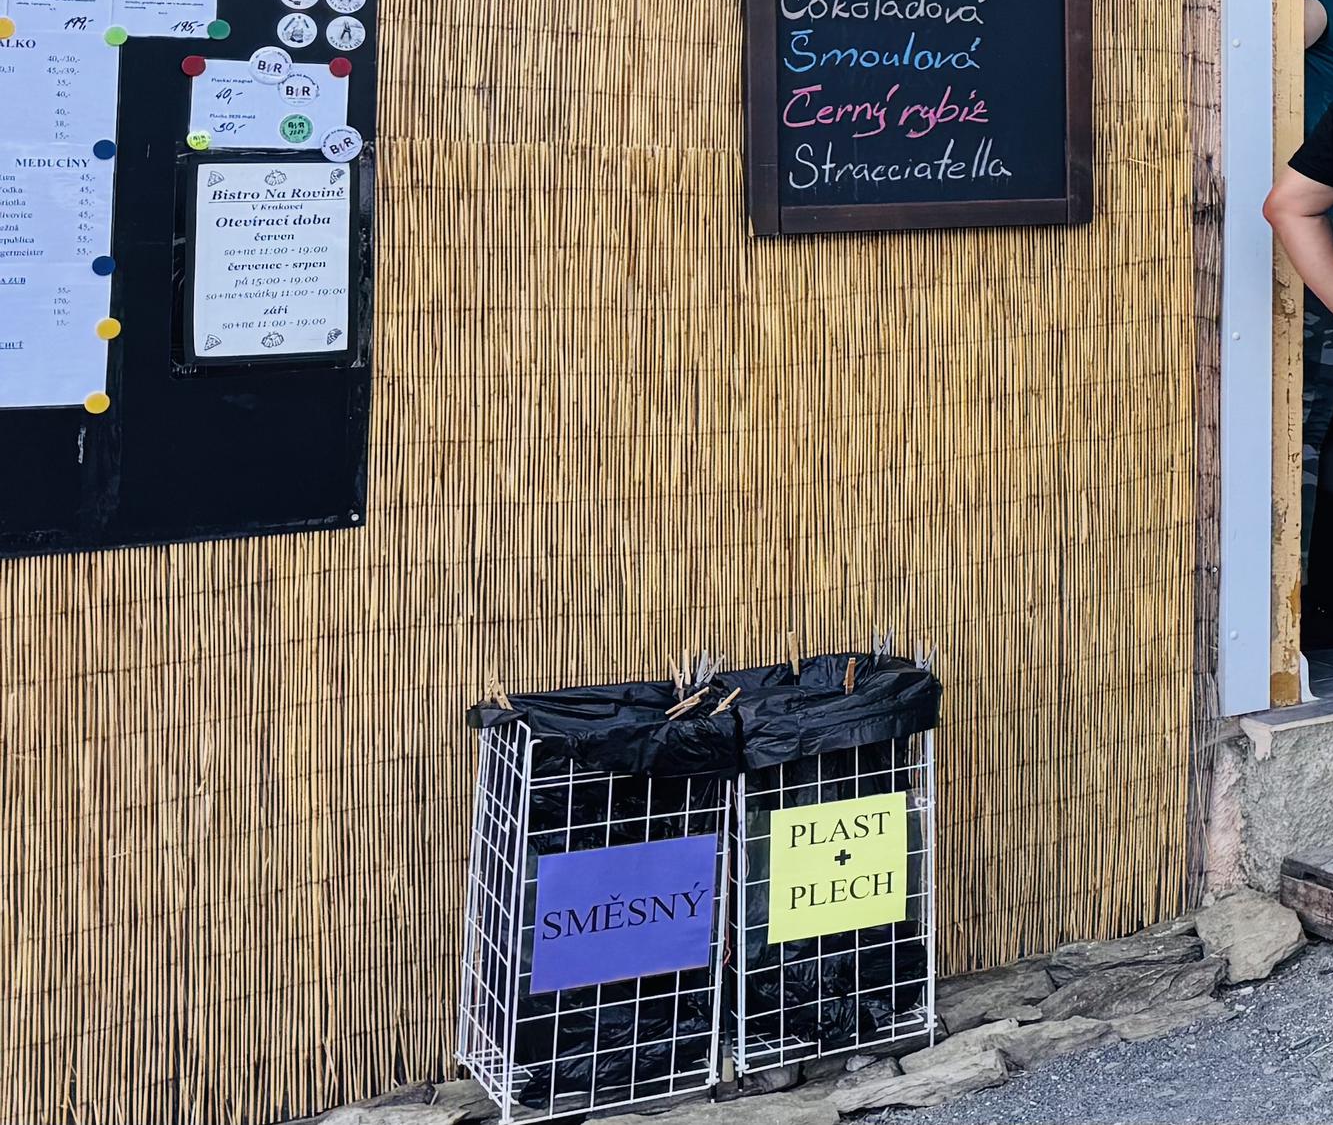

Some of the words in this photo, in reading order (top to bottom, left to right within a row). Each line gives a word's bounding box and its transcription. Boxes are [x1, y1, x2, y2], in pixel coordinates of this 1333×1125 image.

[784, 30, 981, 72] Šmoulová
[783, 84, 900, 137] Černý
[789, 138, 1013, 189] Stracciatella
[212, 189, 260, 201] Bistro
[265, 189, 286, 199] Na
[291, 187, 345, 200] Rovině
[216, 215, 289, 228] Otevírací
[293, 214, 331, 226] doba
[254, 232, 295, 242] červen
[228, 262, 283, 271] červenec
[292, 261, 326, 271] srpen
[789, 811, 892, 848] PLAST
[790, 871, 895, 910] PLECH
[541, 882, 710, 941] SMĚSNÝ
